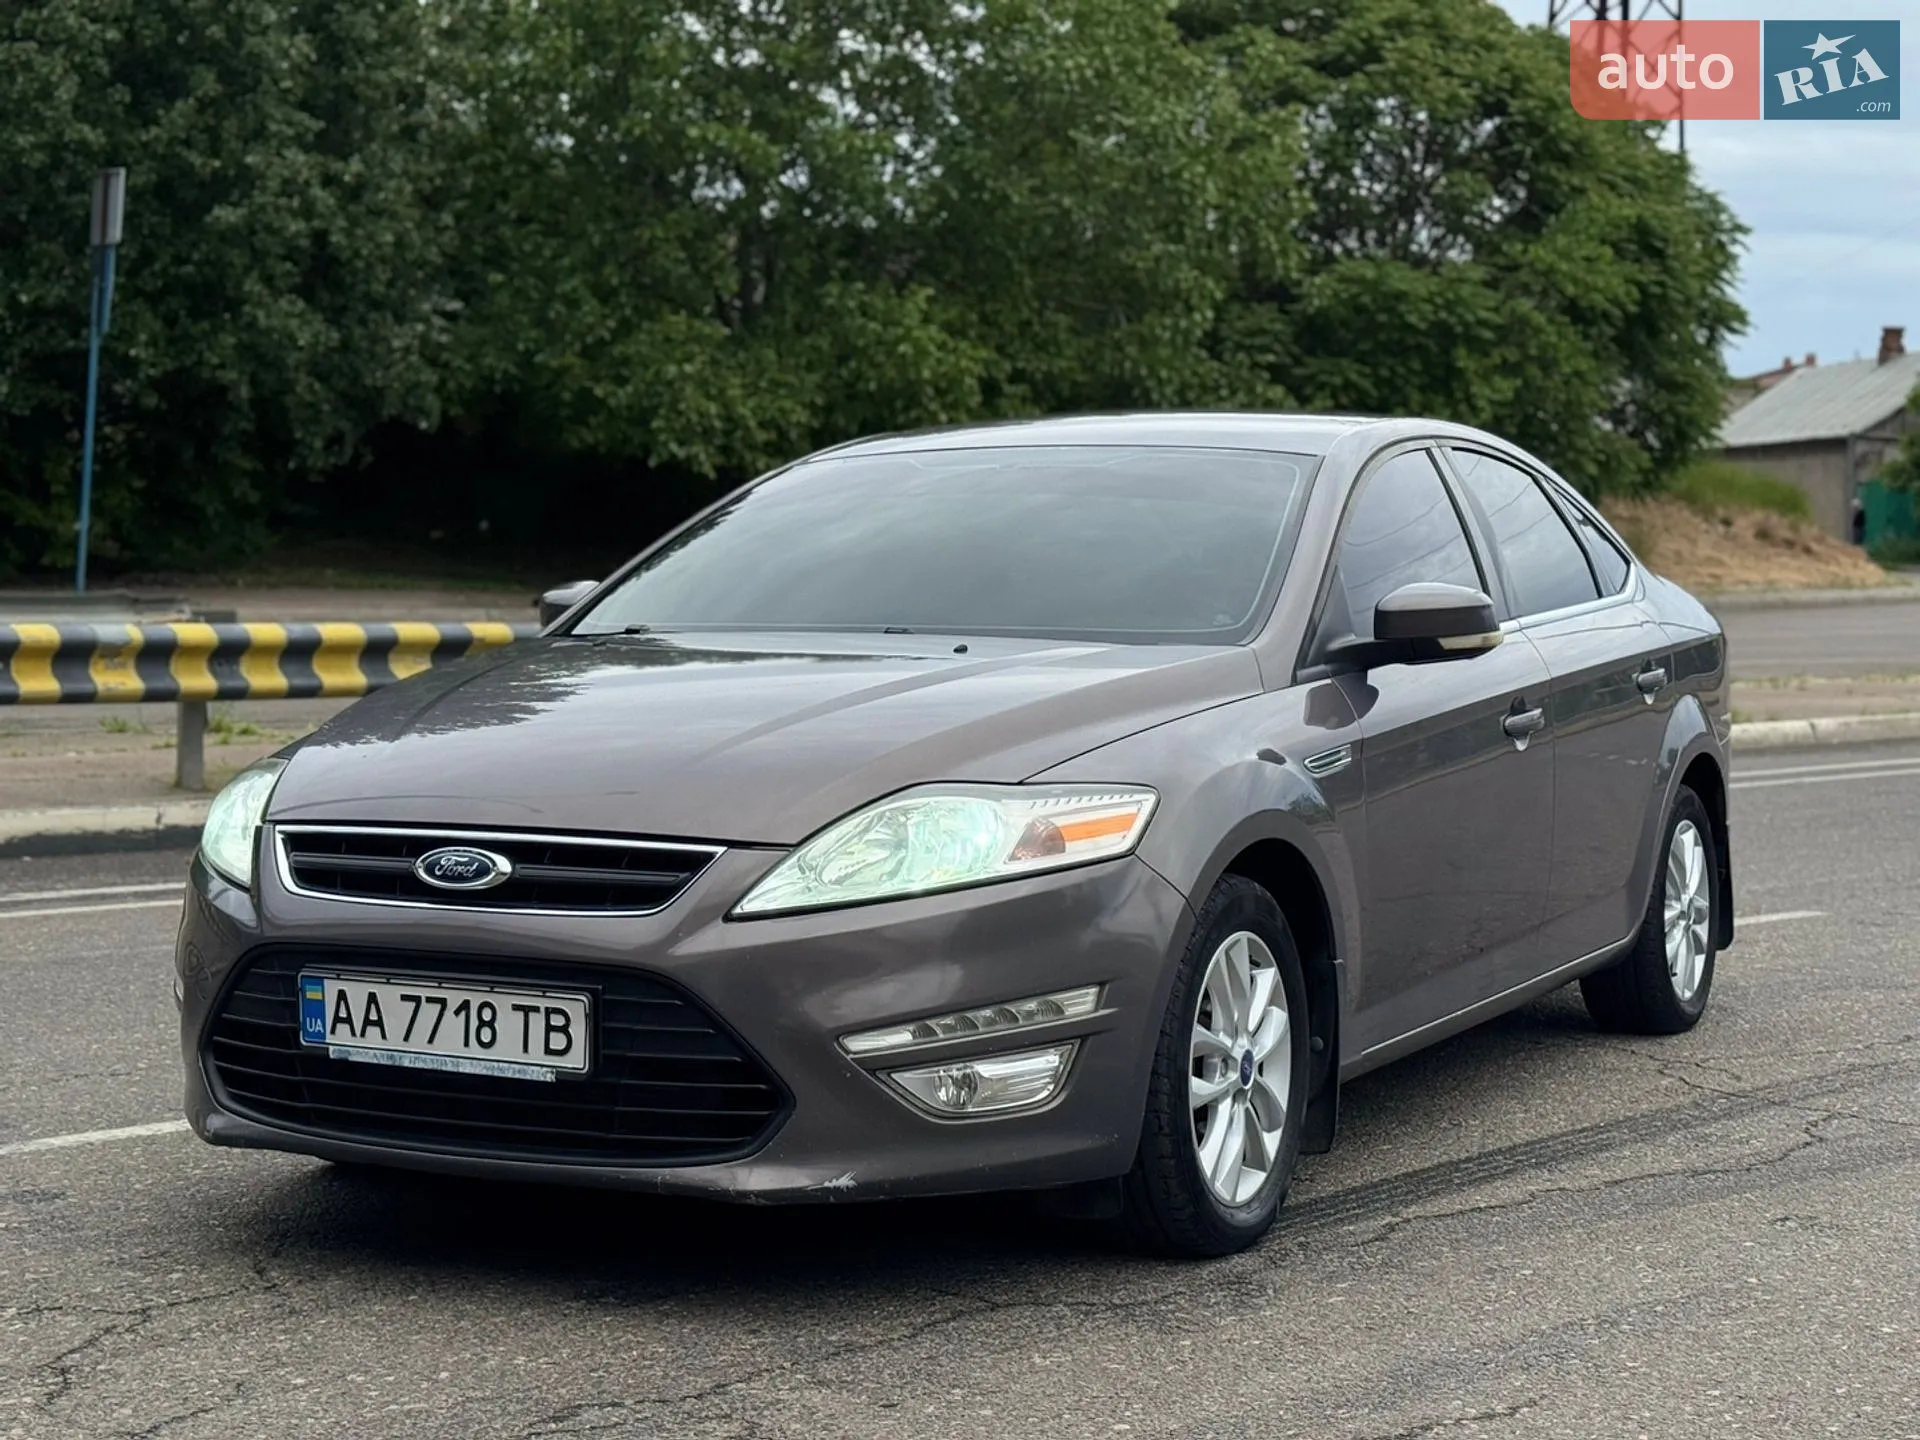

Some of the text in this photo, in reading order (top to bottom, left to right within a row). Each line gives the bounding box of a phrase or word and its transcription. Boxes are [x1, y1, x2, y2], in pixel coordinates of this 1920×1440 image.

[434, 855, 479, 878] Ford
[306, 1017, 324, 1033] UA
[329, 988, 573, 1057] AA 7718 TB
